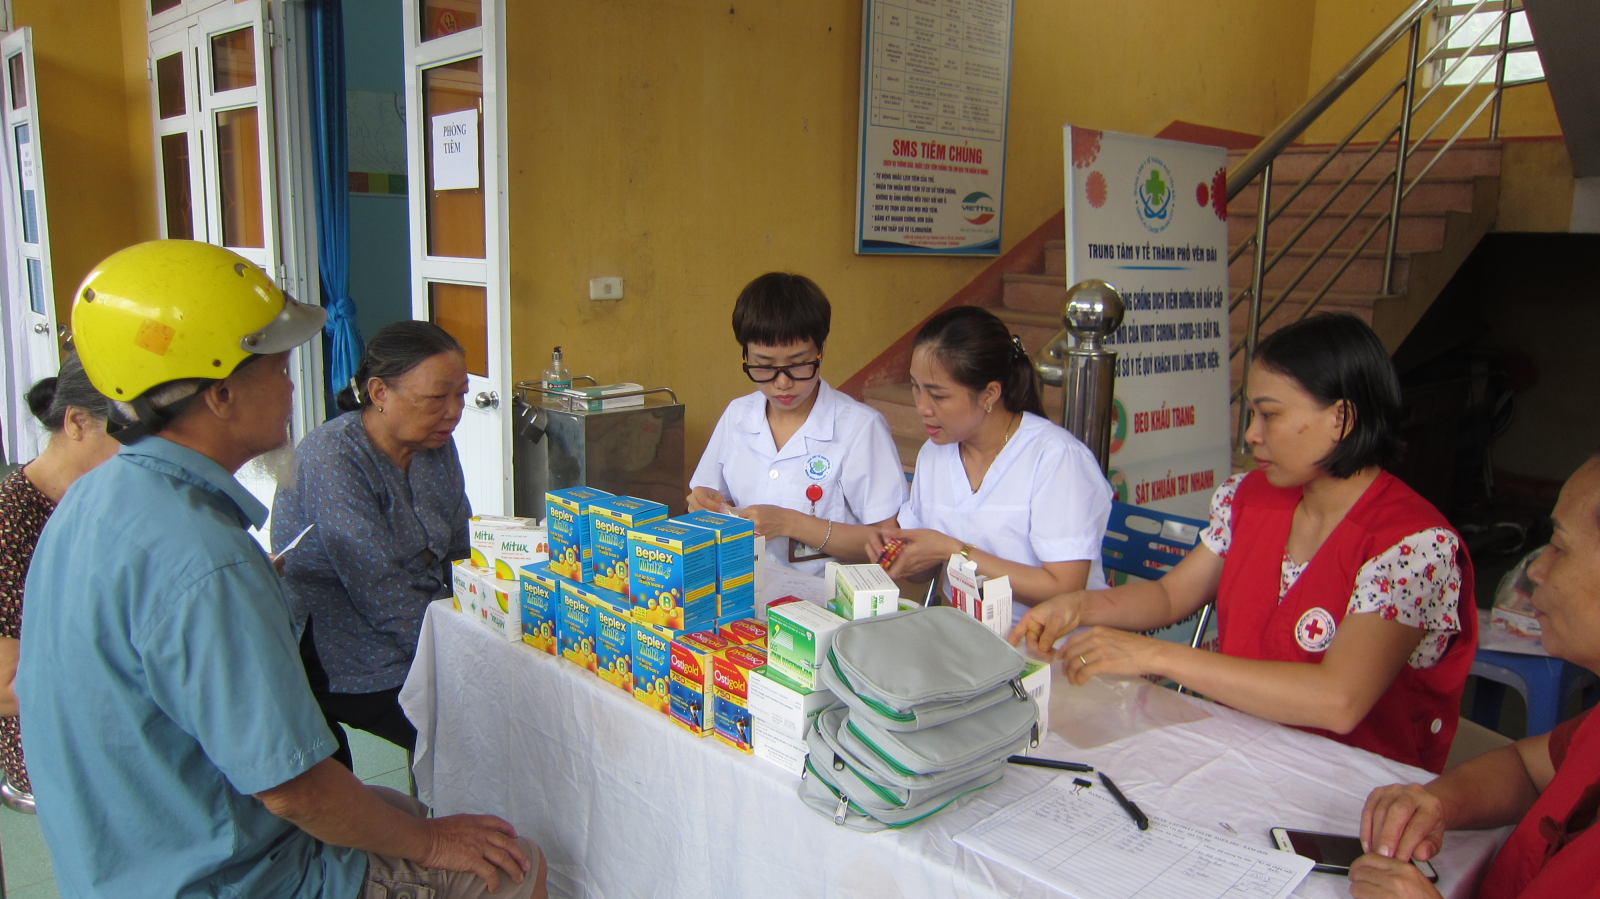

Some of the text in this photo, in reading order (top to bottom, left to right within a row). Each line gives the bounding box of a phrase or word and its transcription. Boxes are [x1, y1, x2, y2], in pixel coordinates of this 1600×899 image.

[443, 122, 466, 137] PHÒNG
[444, 139, 460, 154] TIÊM
[892, 139, 918, 158] SMS
[921, 140, 946, 160] TIÊM
[1088, 241, 1217, 262] TRUNG TÂM Y TẾ THÀNH PHỐ YÊN BÁI
[1128, 319, 1139, 344] CỦA
[1134, 401, 1195, 434] ĐEO KHẨU TRANG
[1135, 469, 1214, 505] SÁT KHUẨN TAY NHANH
[550, 506, 574, 523] Beplex
[474, 530, 494, 541] Mitu
[595, 519, 626, 536] Beplex
[501, 541, 529, 553] Mitux
[636, 546, 673, 564] Beplex
[639, 558, 663, 575] Multi
[524, 581, 550, 599] Beplex
[564, 595, 590, 615] Beplex
[599, 612, 627, 632] Beplex
[637, 630, 666, 652] Beplex
[671, 654, 699, 676] Ostigold
[671, 670, 686, 684] 750
[714, 669, 746, 692] Ostigold
[715, 686, 731, 700] 750
